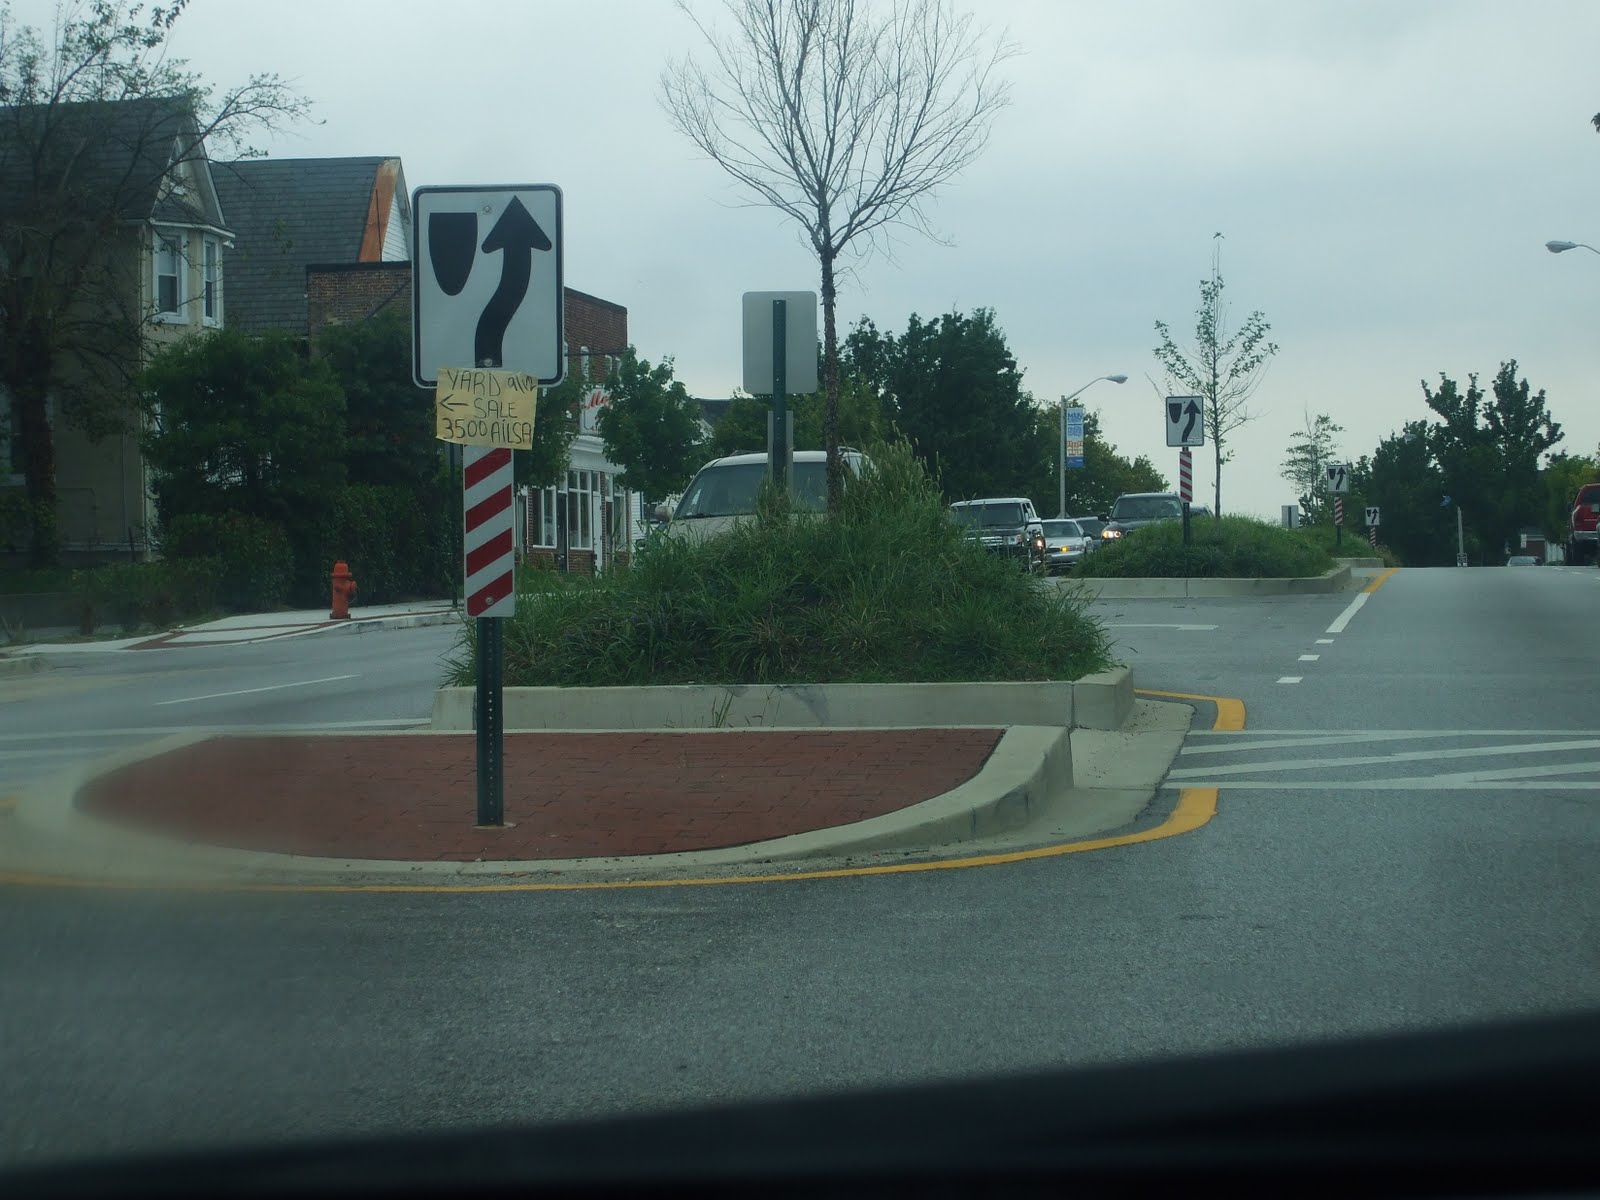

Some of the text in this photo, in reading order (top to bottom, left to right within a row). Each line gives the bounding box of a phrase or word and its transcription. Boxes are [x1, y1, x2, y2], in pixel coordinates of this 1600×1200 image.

[447, 370, 501, 396] YARD
[473, 397, 518, 419] SALE
[442, 417, 488, 439] 3500
